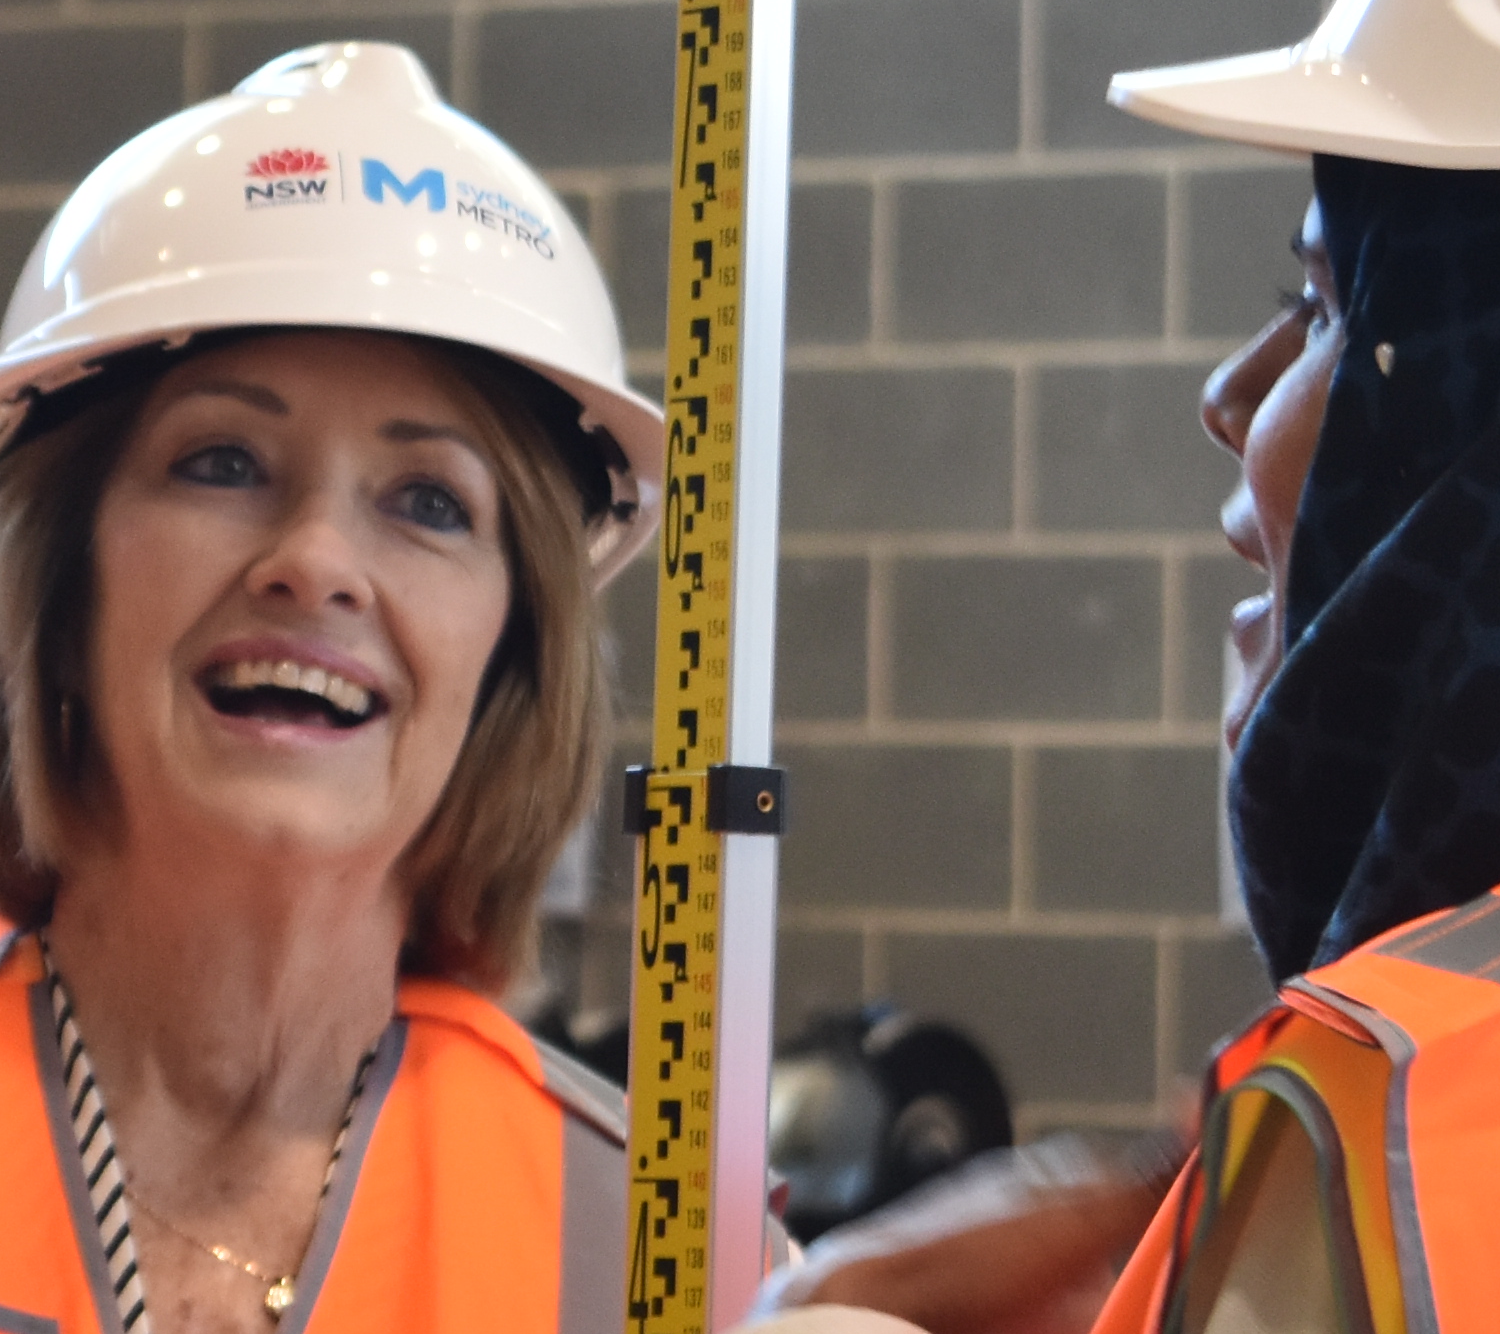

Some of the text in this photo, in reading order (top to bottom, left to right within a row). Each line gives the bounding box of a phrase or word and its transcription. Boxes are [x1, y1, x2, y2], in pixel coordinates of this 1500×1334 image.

[680, 31, 697, 189] 7
[245, 179, 327, 202] NSW
[360, 158, 446, 213] M
[456, 181, 550, 239] sydney
[456, 200, 554, 260] METRO
[664, 418, 684, 579] 6
[641, 809, 662, 970] 5
